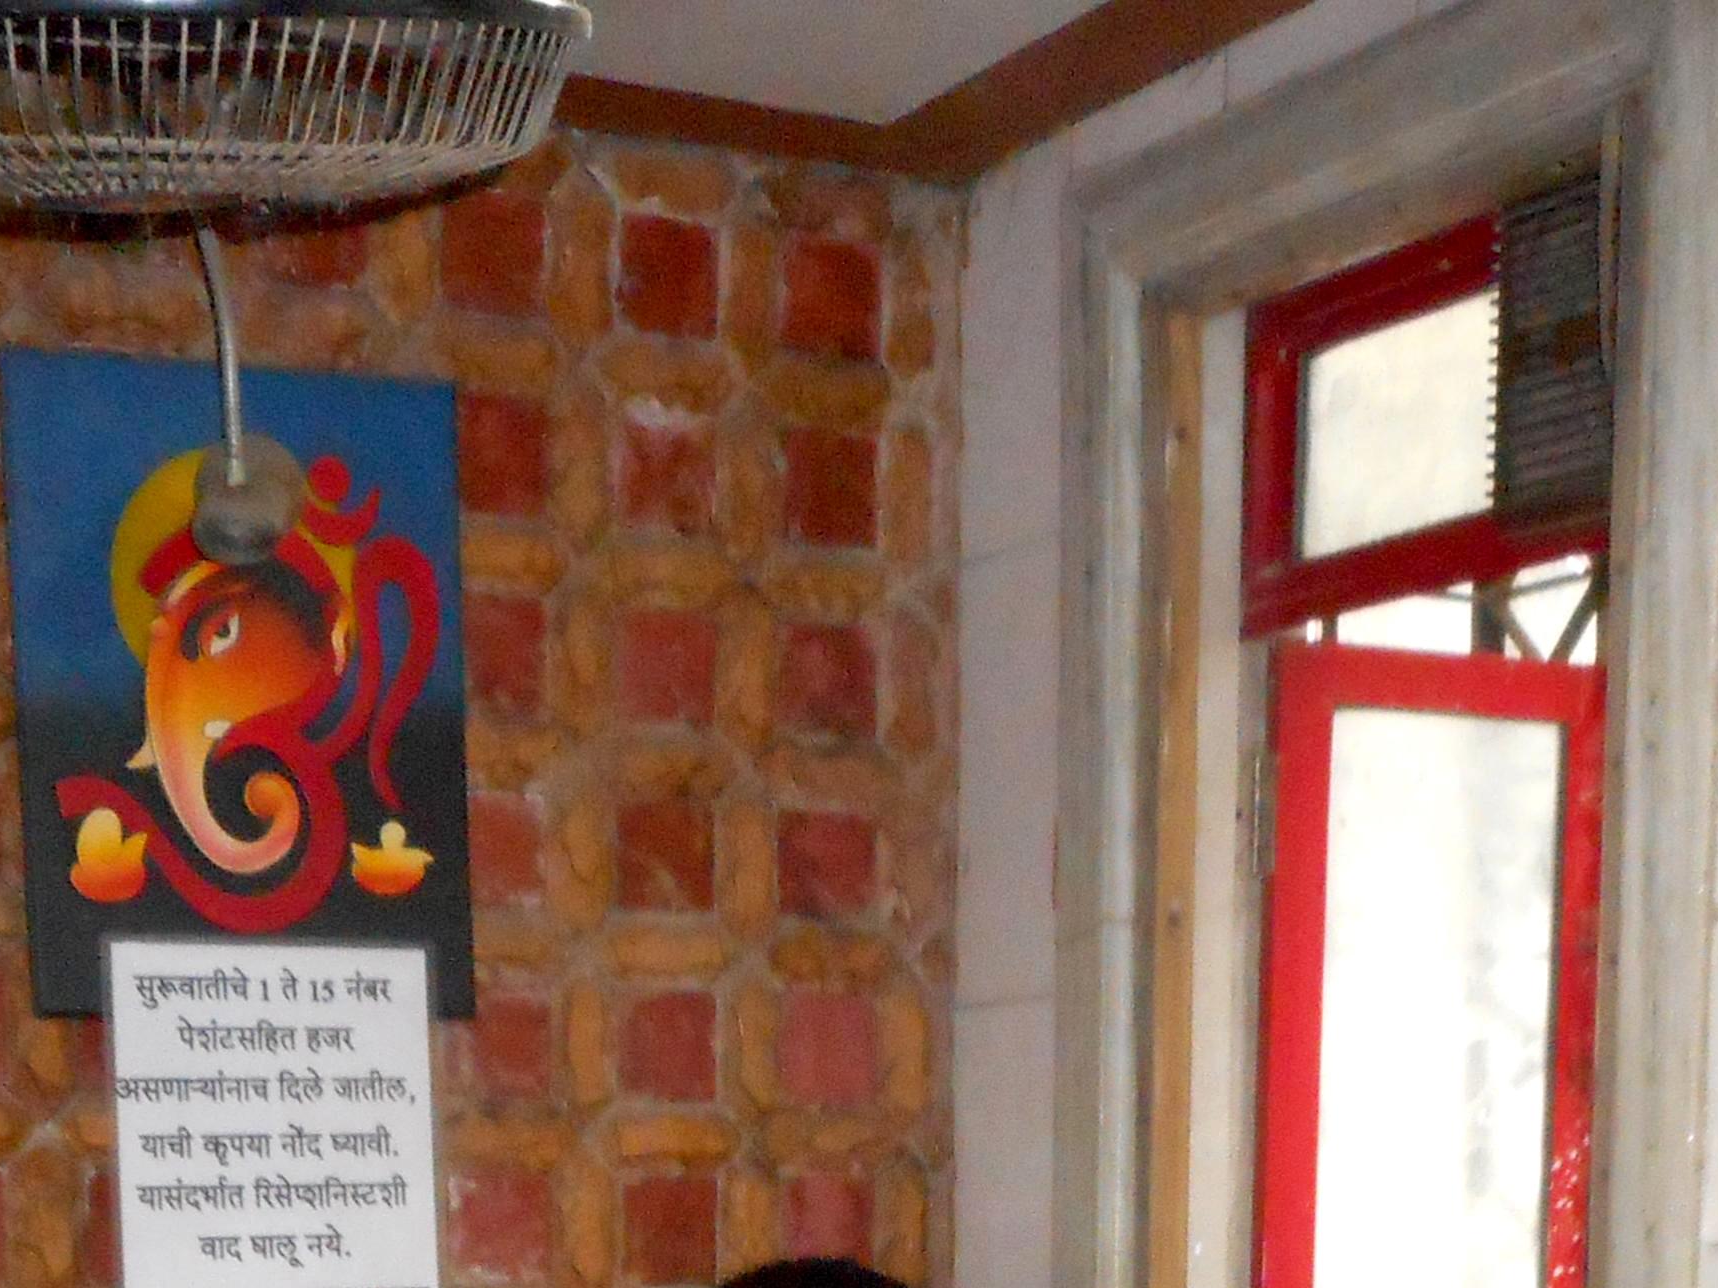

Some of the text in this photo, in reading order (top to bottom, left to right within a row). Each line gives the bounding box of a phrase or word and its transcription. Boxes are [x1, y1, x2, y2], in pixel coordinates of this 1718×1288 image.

[260, 982, 270, 1003] 1
[281, 968, 300, 1003] ते
[310, 981, 335, 1002] 15
[345, 971, 393, 1003] नंबर
[178, 1015, 356, 1053] पेशंटसहित हजर
[278, 1067, 324, 1101] दिले
[139, 1126, 193, 1161] याची
[202, 1132, 272, 1167] कृपया
[281, 1123, 324, 1160] नोंद
[136, 1175, 245, 1211] यासंदर्भात
[199, 1225, 353, 1268] वाद घालू नये.
